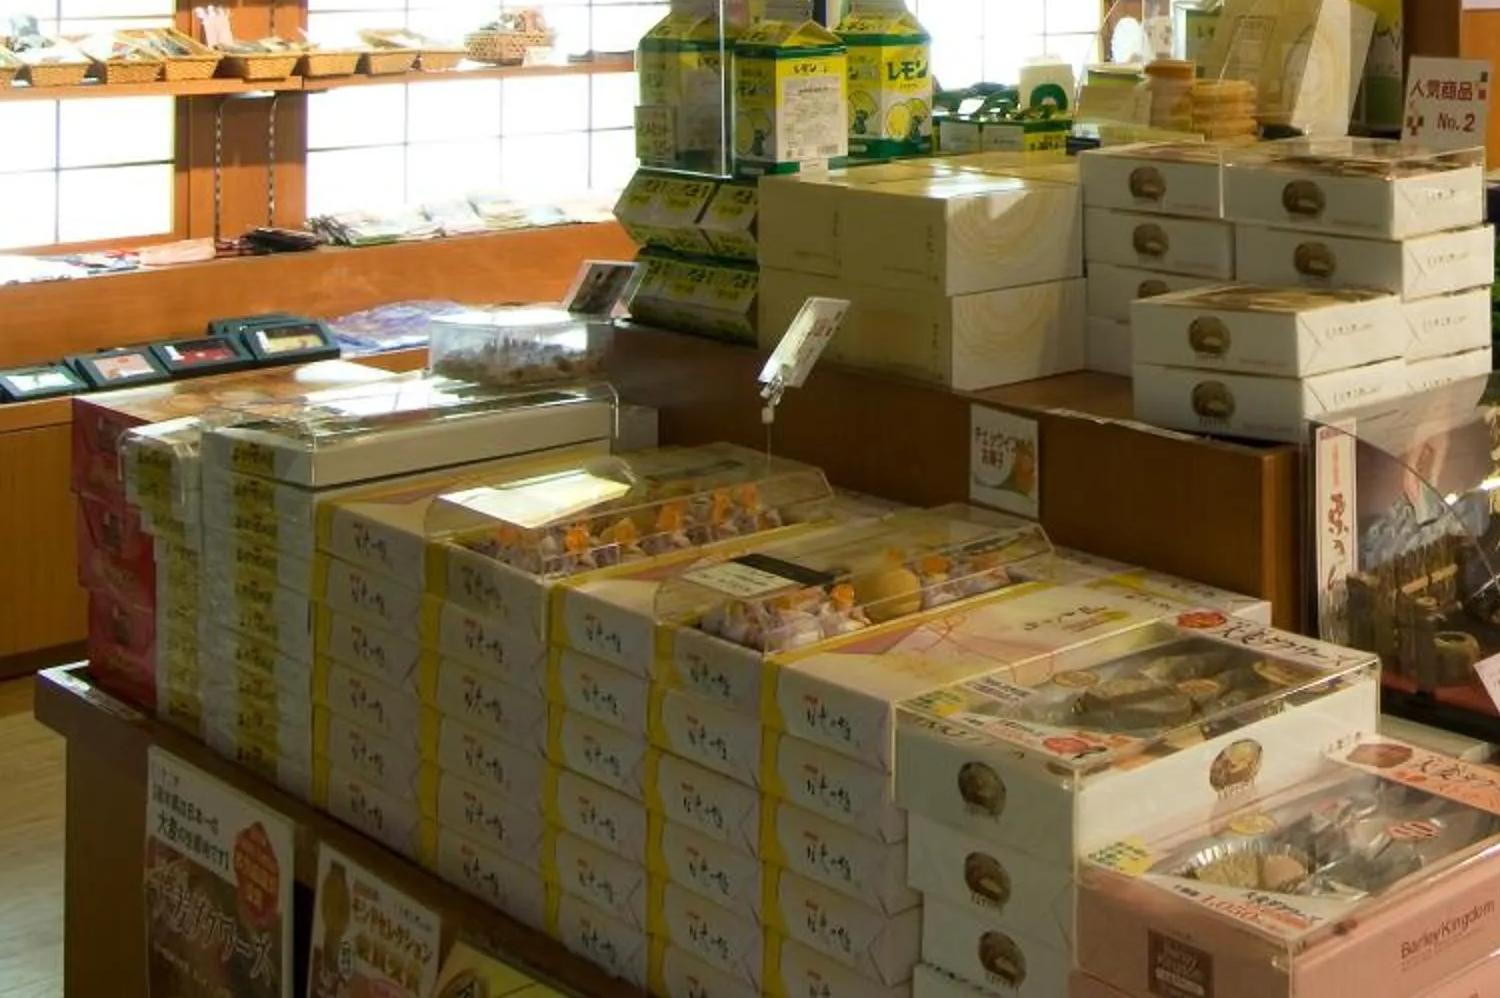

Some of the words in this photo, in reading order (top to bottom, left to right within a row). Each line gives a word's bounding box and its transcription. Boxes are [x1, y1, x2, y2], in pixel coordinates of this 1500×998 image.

[886, 60, 928, 81] レモン
[1410, 79, 1473, 101] 人気商品
[1437, 112, 1476, 132] No.2
